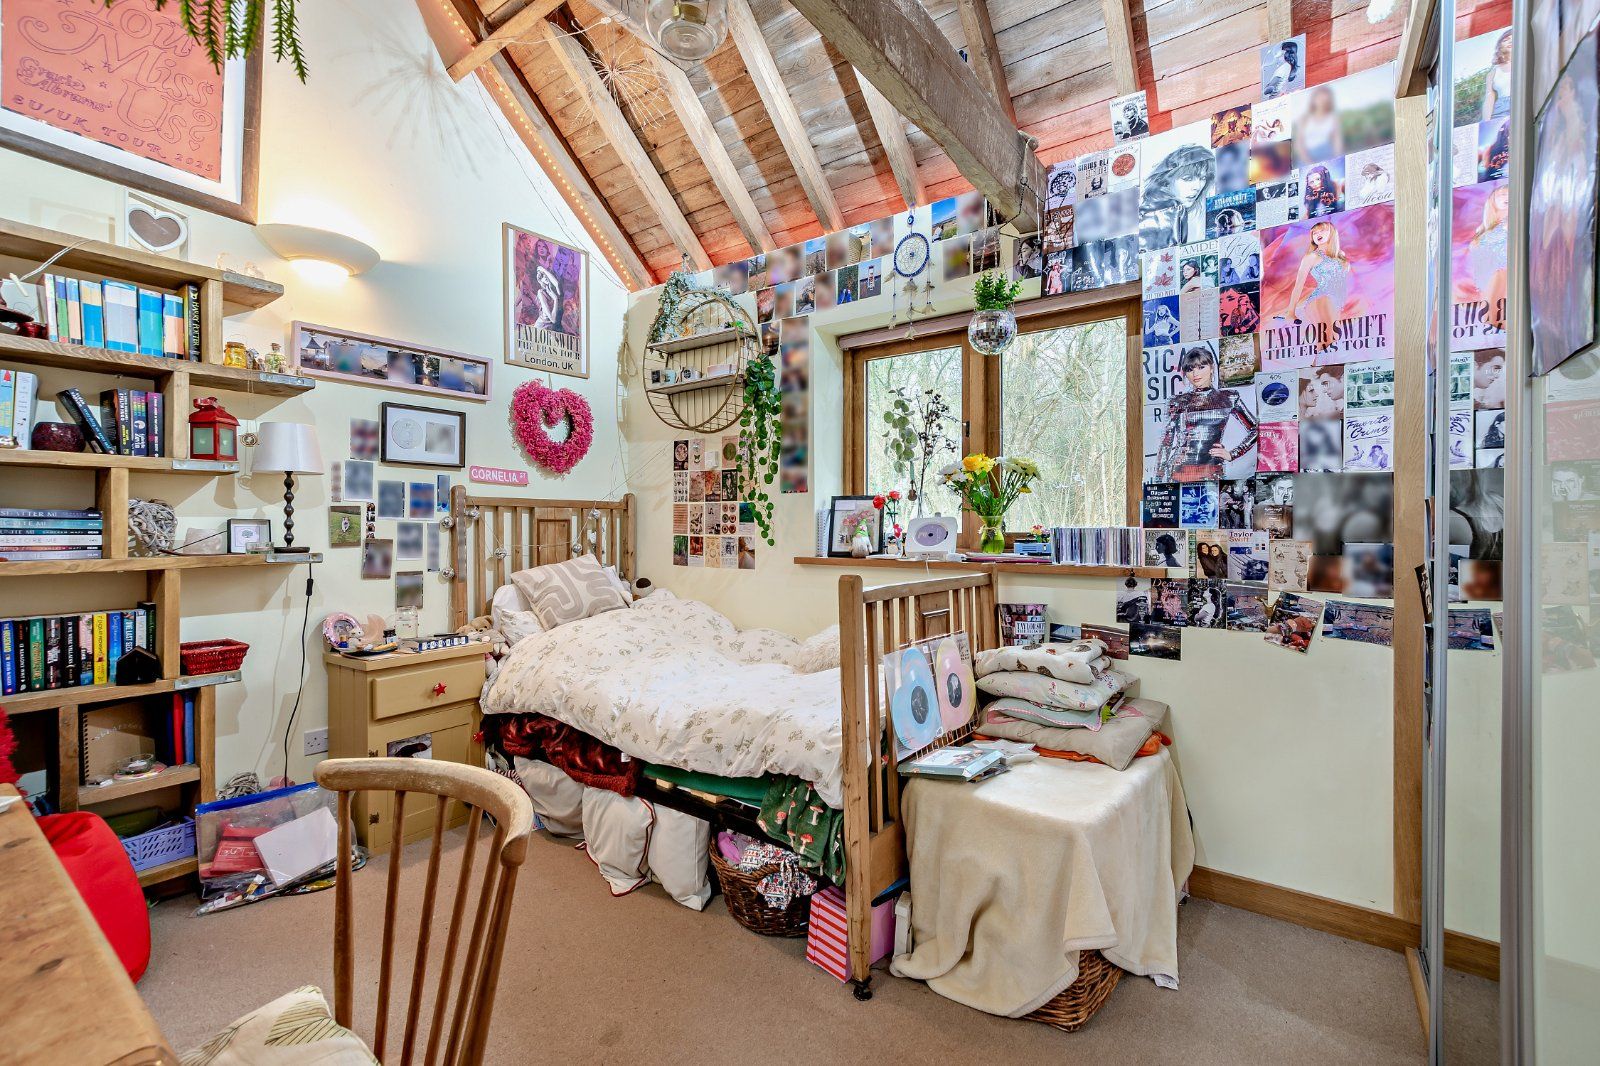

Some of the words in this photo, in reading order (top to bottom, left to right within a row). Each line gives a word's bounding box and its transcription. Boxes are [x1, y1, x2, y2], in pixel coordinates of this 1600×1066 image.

[102, 126, 167, 158] TOUR
[175, 153, 213, 172] 2025
[1078, 160, 1097, 172] SIRIUS
[192, 323, 200, 346] POTTER
[517, 323, 551, 346] TAYLOR
[554, 332, 579, 351] SWIFT
[1266, 322, 1328, 349] TAYLOR
[1333, 313, 1387, 341] SWIFT
[1266, 346, 1295, 360] THE
[1299, 342, 1338, 356] ERAS
[1342, 336, 1386, 351] TOUR
[561, 362, 574, 371] UK
[1346, 415, 1391, 430] Favorite
[1350, 425, 1390, 439] Crime
[471, 468, 519, 483] CORNELIA
[1152, 578, 1177, 587] Dear
